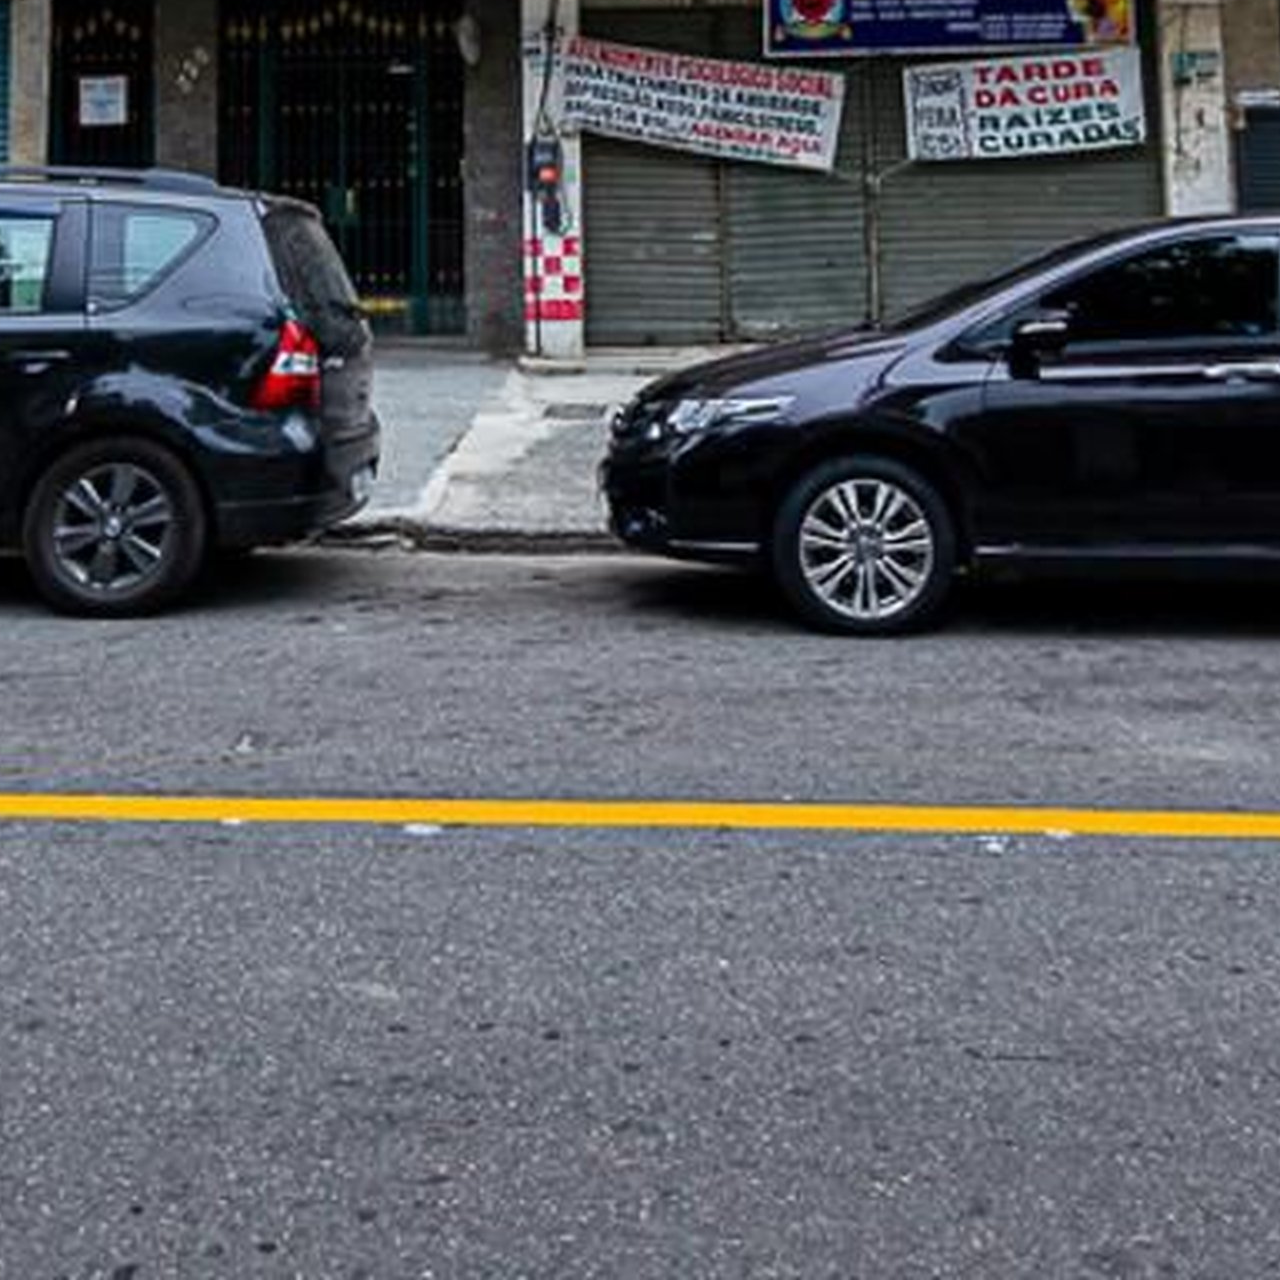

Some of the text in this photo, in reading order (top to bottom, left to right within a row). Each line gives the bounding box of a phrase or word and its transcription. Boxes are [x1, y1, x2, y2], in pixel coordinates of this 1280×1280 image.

[974, 58, 1104, 84] TARDE
[974, 79, 1119, 108] DA CURA
[978, 116, 1142, 154] CURADAS
